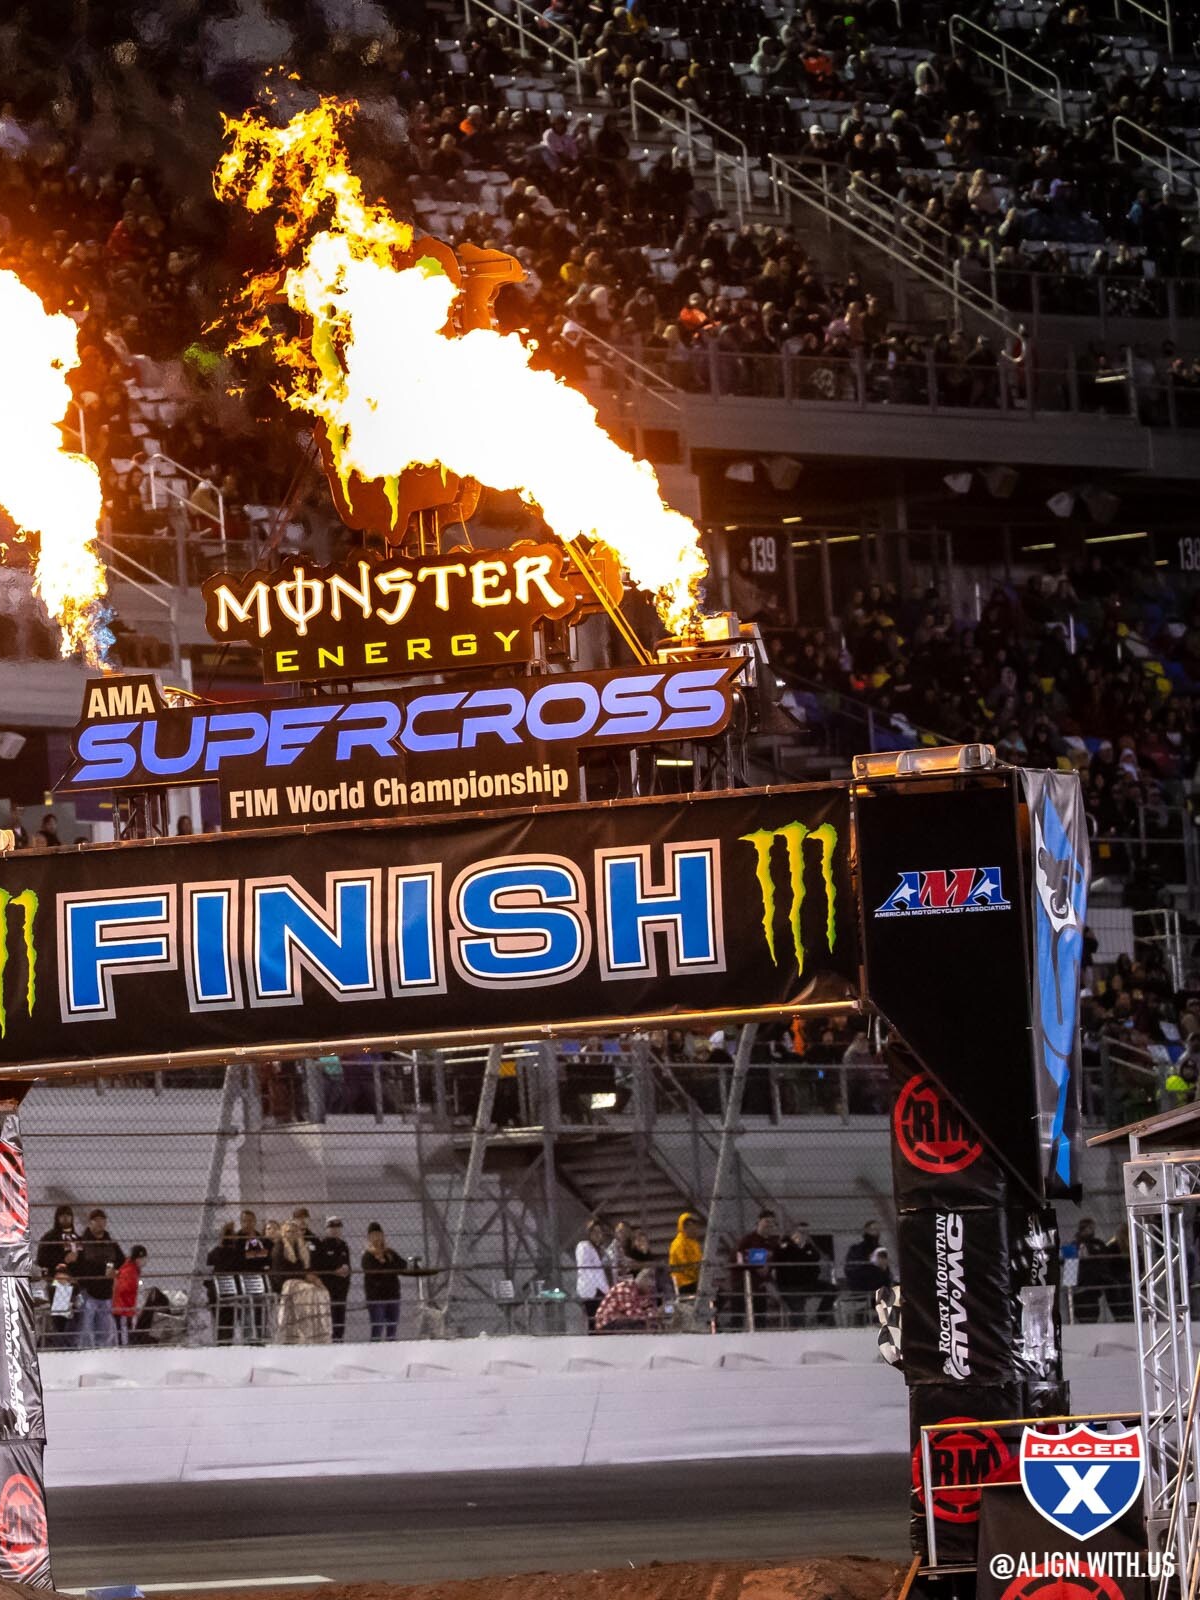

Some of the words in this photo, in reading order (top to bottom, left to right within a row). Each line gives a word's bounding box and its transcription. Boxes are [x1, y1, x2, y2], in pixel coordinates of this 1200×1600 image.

[749, 536, 776, 572] 139
[213, 554, 566, 637] MONSTER
[275, 629, 521, 672] ENERGY
[71, 668, 730, 783] SUPERCROSS
[87, 684, 156, 719] AMA
[229, 788, 279, 819] FIM
[286, 780, 365, 814] World
[373, 763, 569, 809] Championship
[873, 867, 1011, 912] AMA
[911, 907, 964, 916] MOTORCYCLIST
[965, 904, 1011, 913] ASSOCIATION
[57, 839, 726, 1022] FINISH
[935, 1213, 950, 1301] MOUNTAIN
[938, 1302, 952, 1353] ROCKY
[930, 1447, 991, 1490] RM
